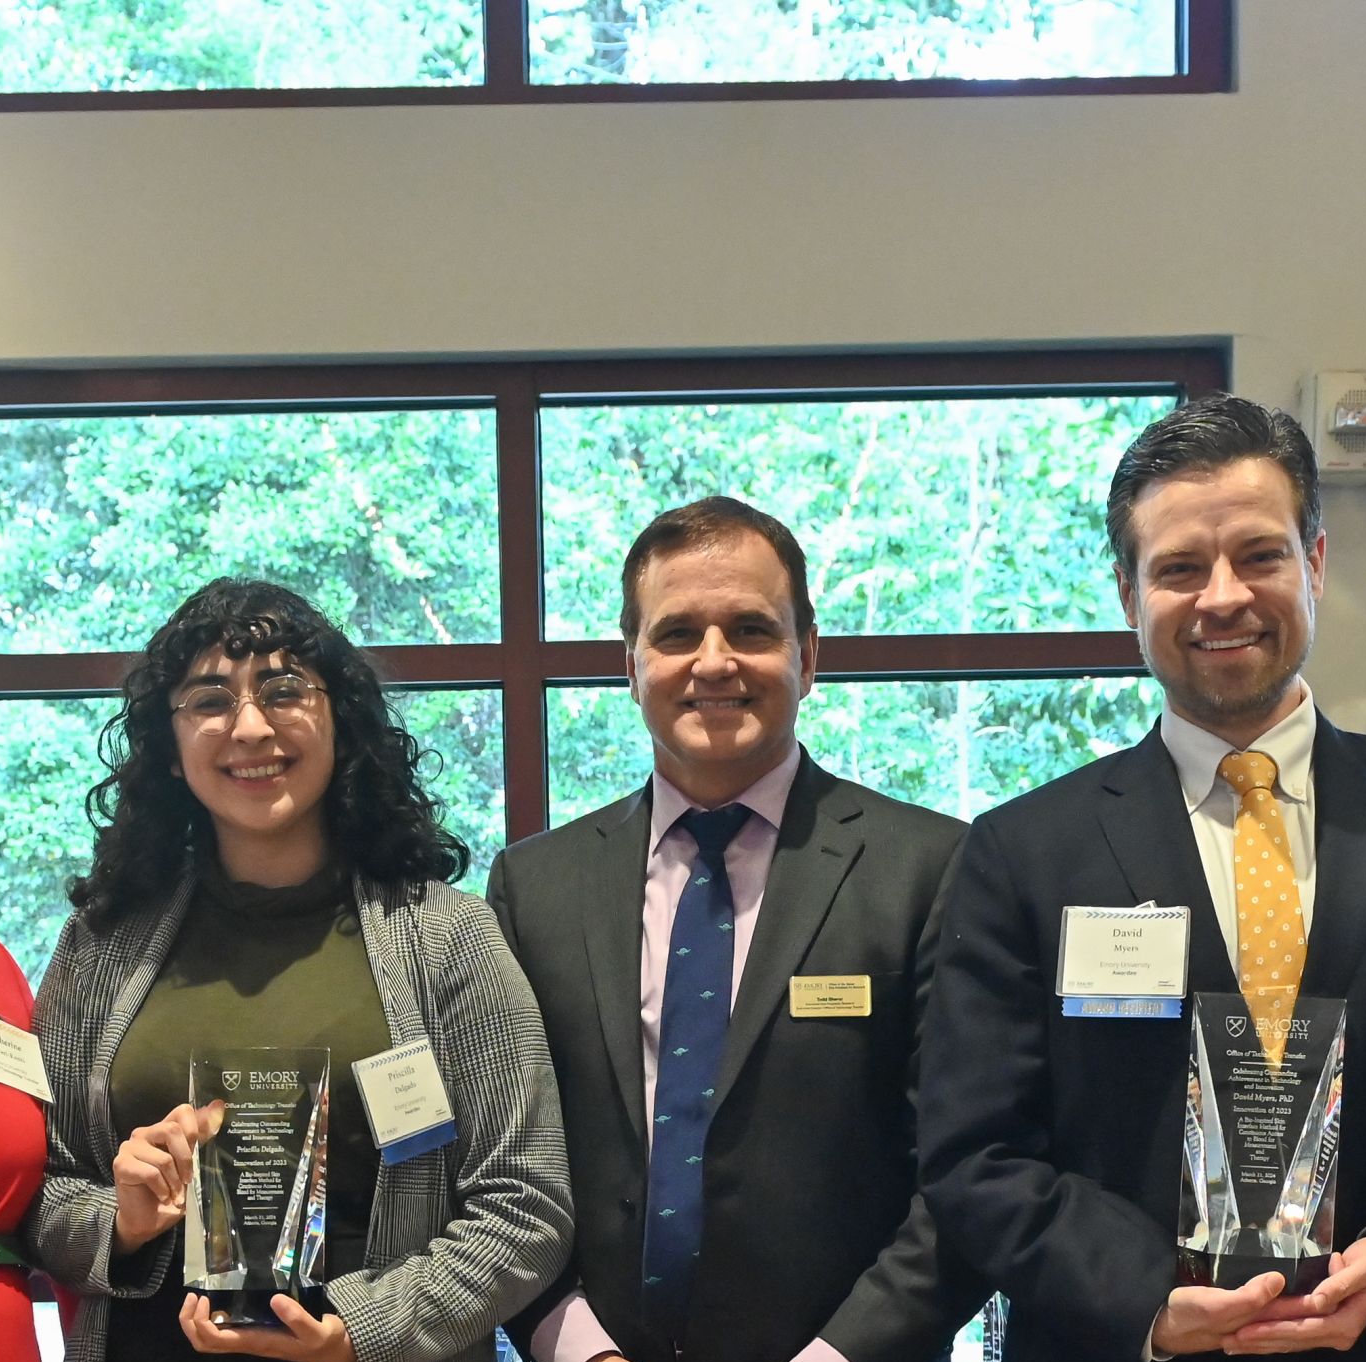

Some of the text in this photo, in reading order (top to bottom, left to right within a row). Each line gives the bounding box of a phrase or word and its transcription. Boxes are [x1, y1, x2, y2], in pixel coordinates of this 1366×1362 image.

[1112, 928, 1143, 938] David
[1114, 944, 1138, 953] Myers
[1256, 1017, 1311, 1032] EMORY
[1255, 1030, 1309, 1040] URSITY
[249, 1071, 300, 1083] EMORY
[387, 1065, 415, 1080] Priscilla
[394, 1080, 417, 1094] Delgado
[1233, 1092, 1253, 1100] David
[1278, 1094, 1294, 1103] PhD
[1233, 1105, 1267, 1113] Innovation
[236, 1145, 285, 1154] Priscilla Delgado
